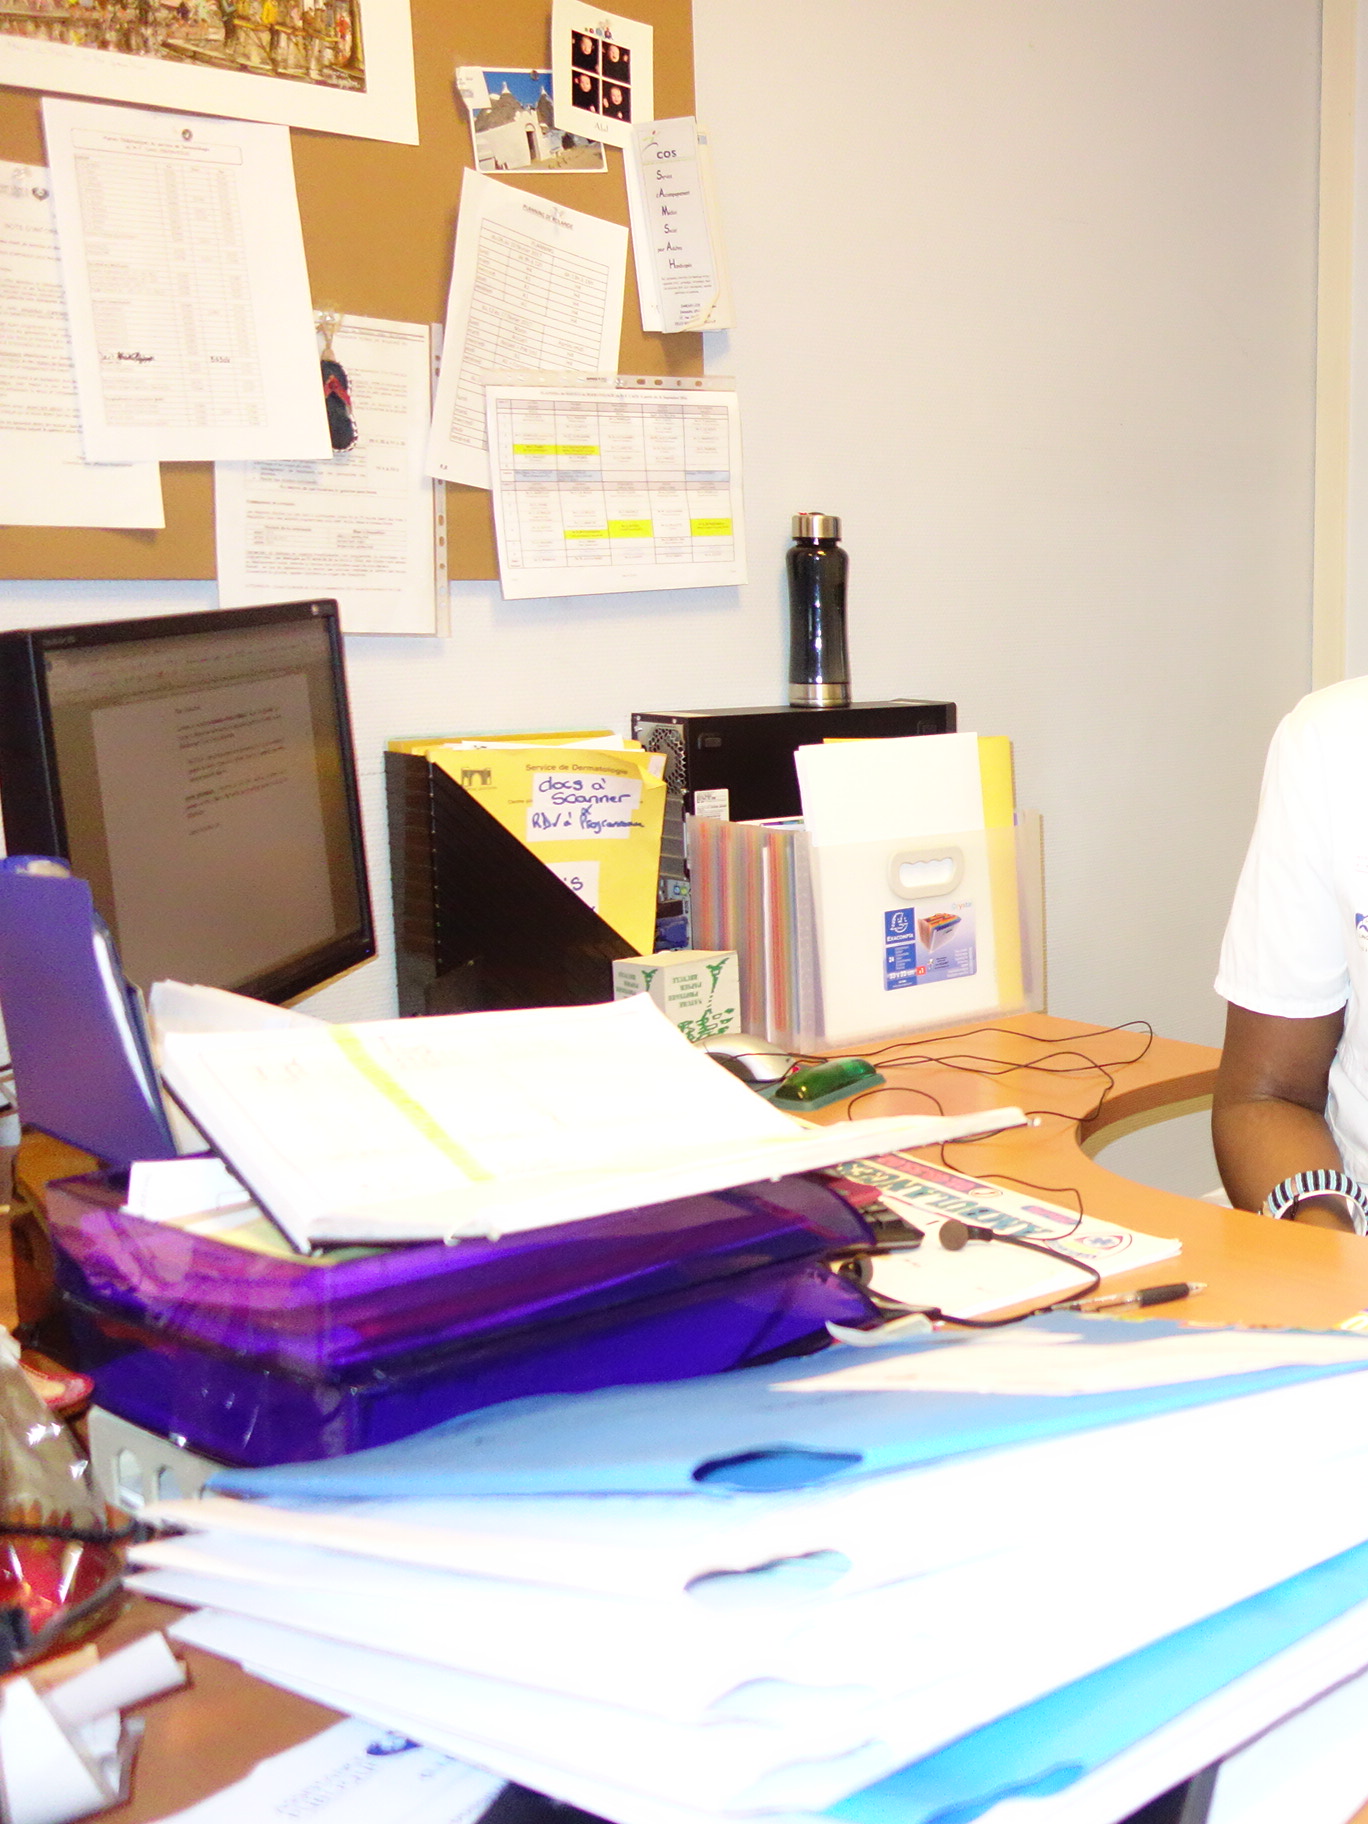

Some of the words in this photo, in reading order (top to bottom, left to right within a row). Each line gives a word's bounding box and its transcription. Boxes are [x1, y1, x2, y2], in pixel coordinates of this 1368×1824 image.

[657, 149, 677, 159] COS
[525, 764, 557, 772] Service
[572, 764, 628, 775] Dermatologie
[538, 777, 584, 793] docs
